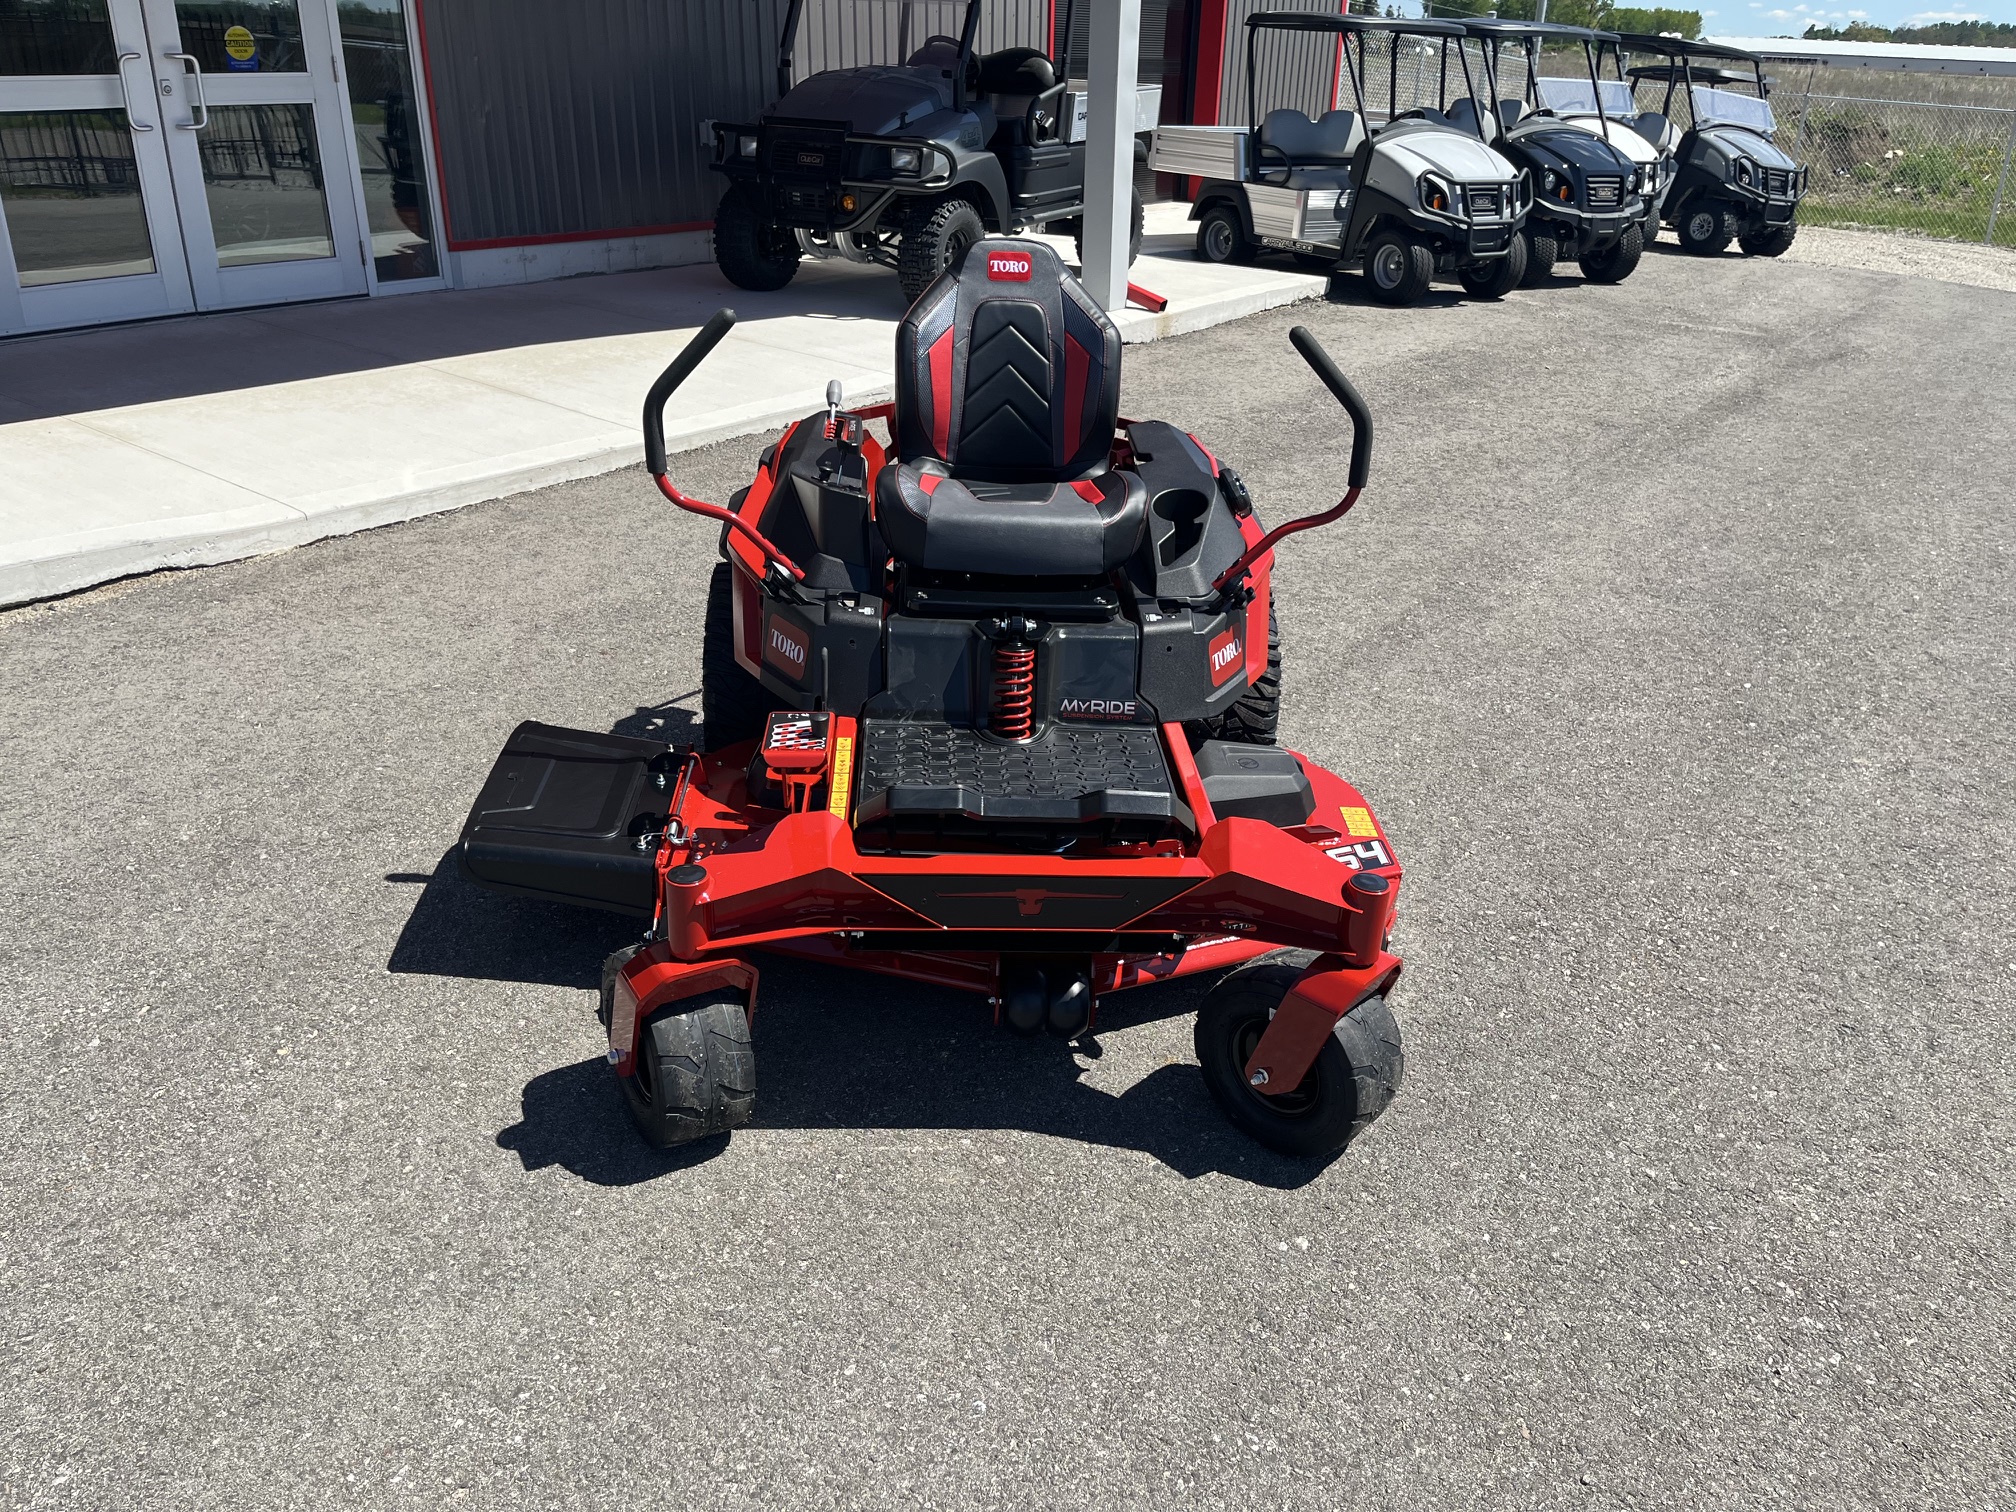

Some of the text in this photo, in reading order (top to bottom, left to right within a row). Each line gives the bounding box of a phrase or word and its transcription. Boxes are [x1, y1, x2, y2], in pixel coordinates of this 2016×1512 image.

[1262, 237, 1313, 253] CARRYALL 300
[990, 260, 1029, 273] TORO
[771, 628, 804, 664] TORO
[1212, 638, 1240, 671] TORO
[1325, 840, 1389, 870] 54
